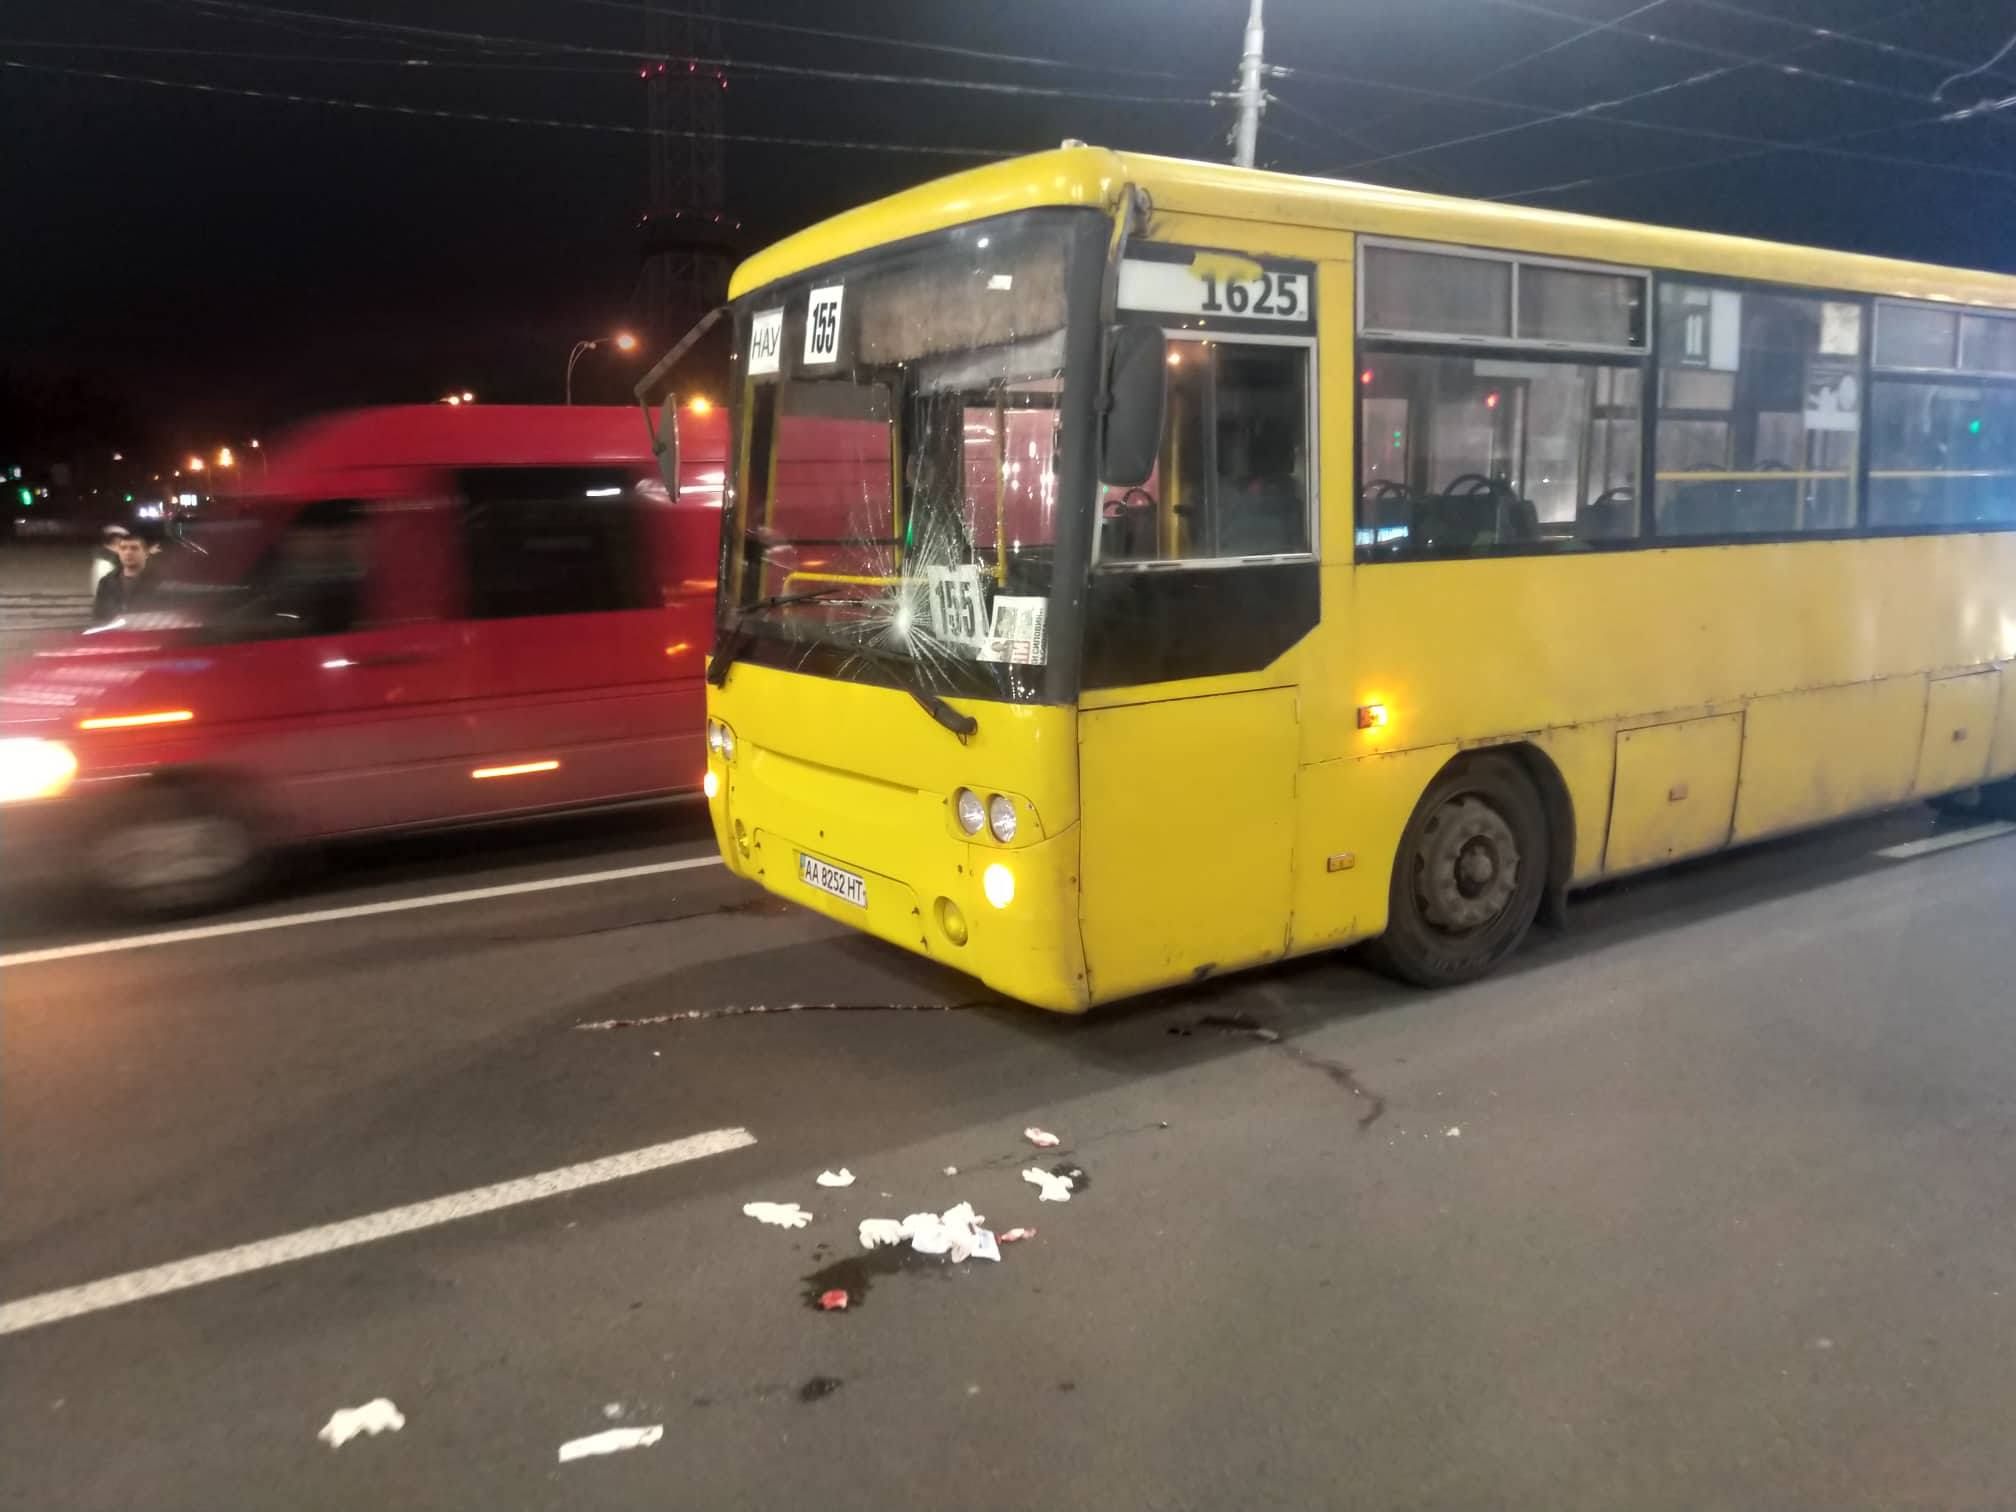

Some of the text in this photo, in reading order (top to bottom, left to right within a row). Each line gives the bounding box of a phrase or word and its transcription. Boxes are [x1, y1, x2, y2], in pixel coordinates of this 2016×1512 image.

[1201, 268, 1298, 316] 1625
[811, 301, 838, 354] 155
[935, 579, 976, 638] 155
[805, 860, 863, 902] AA 8252 HT
